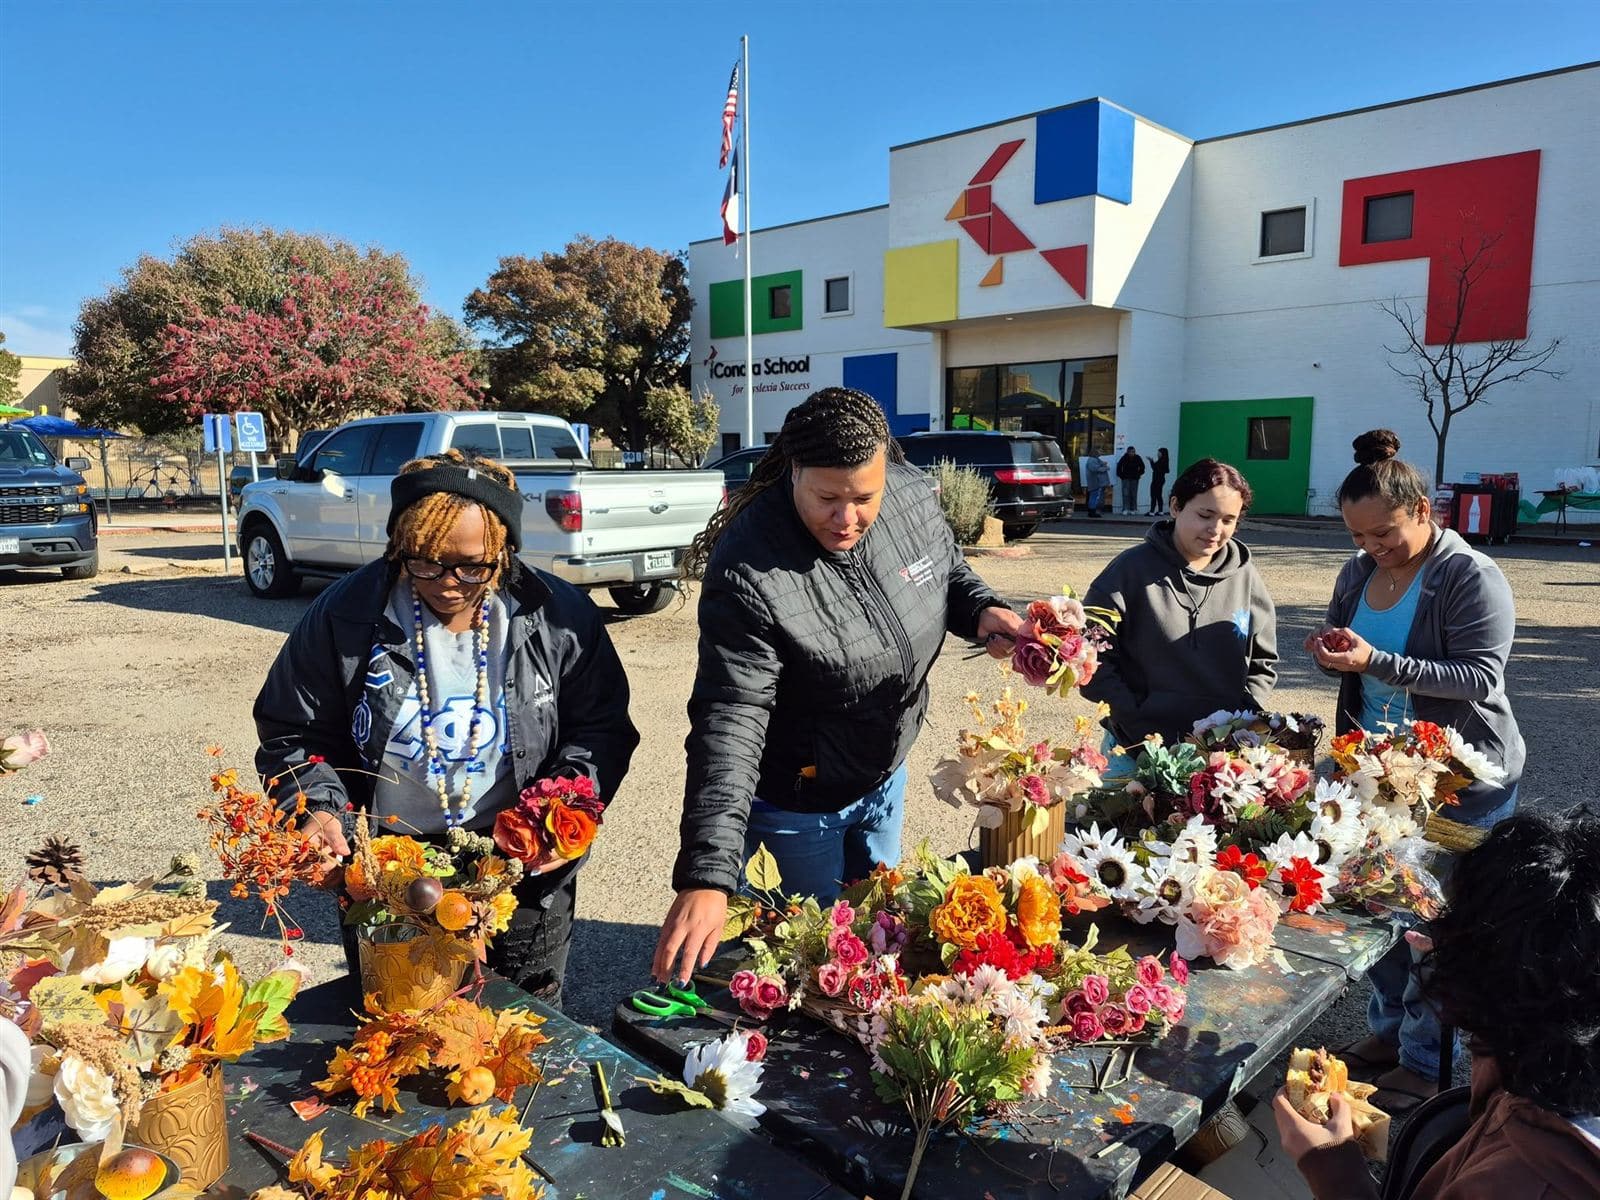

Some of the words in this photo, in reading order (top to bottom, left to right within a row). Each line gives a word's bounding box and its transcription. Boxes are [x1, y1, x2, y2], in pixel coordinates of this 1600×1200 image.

[764, 356, 810, 375] School
[731, 384, 744, 396] for
[779, 381, 810, 392] Success
[1119, 395, 1126, 408] 1
